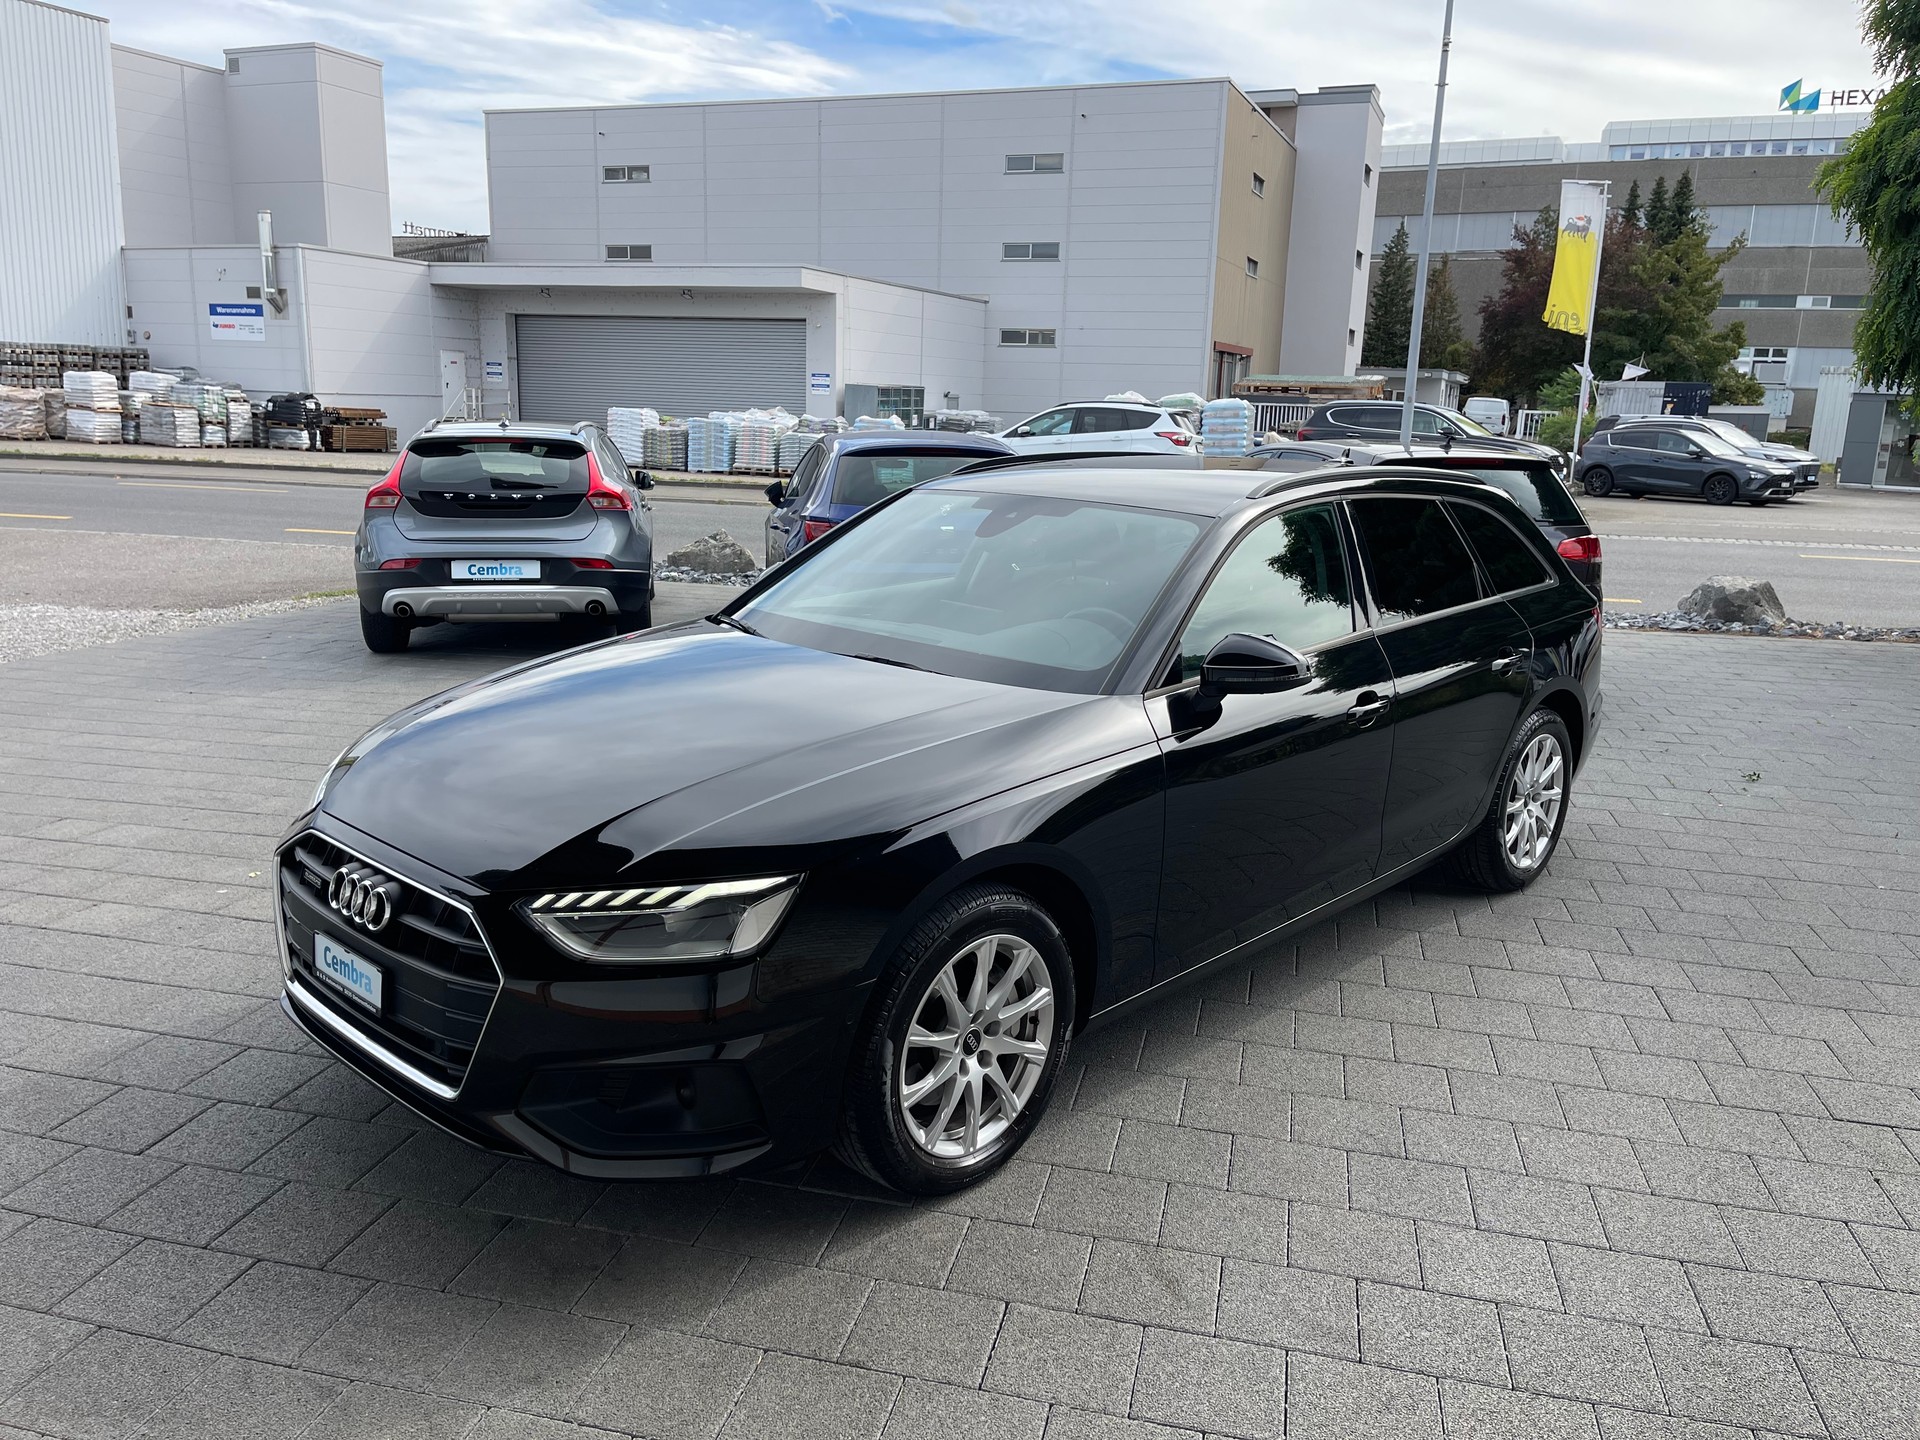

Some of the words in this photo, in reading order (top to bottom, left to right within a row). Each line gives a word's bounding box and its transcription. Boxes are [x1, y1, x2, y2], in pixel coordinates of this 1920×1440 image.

[216, 306, 256, 314] Warenannahme
[467, 563, 523, 576] Cembra
[323, 945, 374, 996] Cembra
